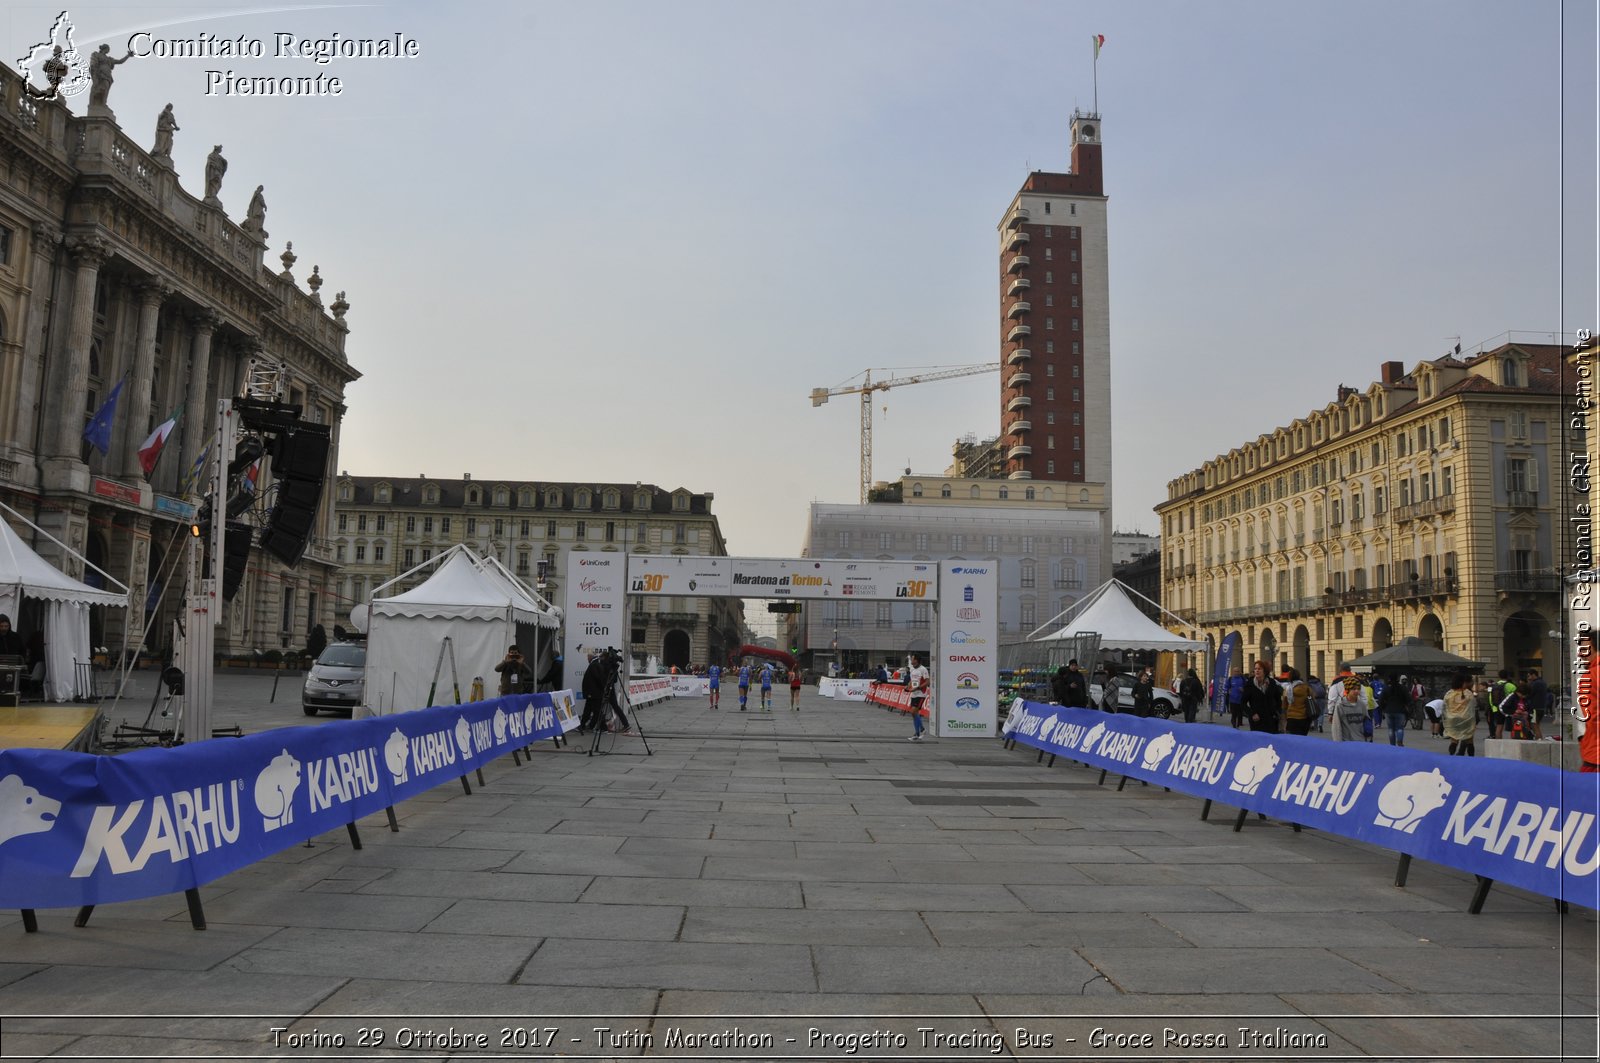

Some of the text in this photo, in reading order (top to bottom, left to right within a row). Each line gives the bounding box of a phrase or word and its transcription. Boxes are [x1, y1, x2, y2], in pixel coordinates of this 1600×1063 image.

[733, 573, 777, 586] Maratona
[779, 576, 790, 586] di
[791, 573, 823, 586] Torino
[576, 601, 600, 609] fischer
[585, 626, 609, 635] iren
[951, 637, 986, 645] bluetorino
[948, 720, 987, 729] Tailorsan
[1050, 721, 1084, 749] KARHU
[411, 729, 456, 776] KARHU
[1096, 730, 1144, 765] KARHU
[1440, 790, 1600, 877] KARHU
